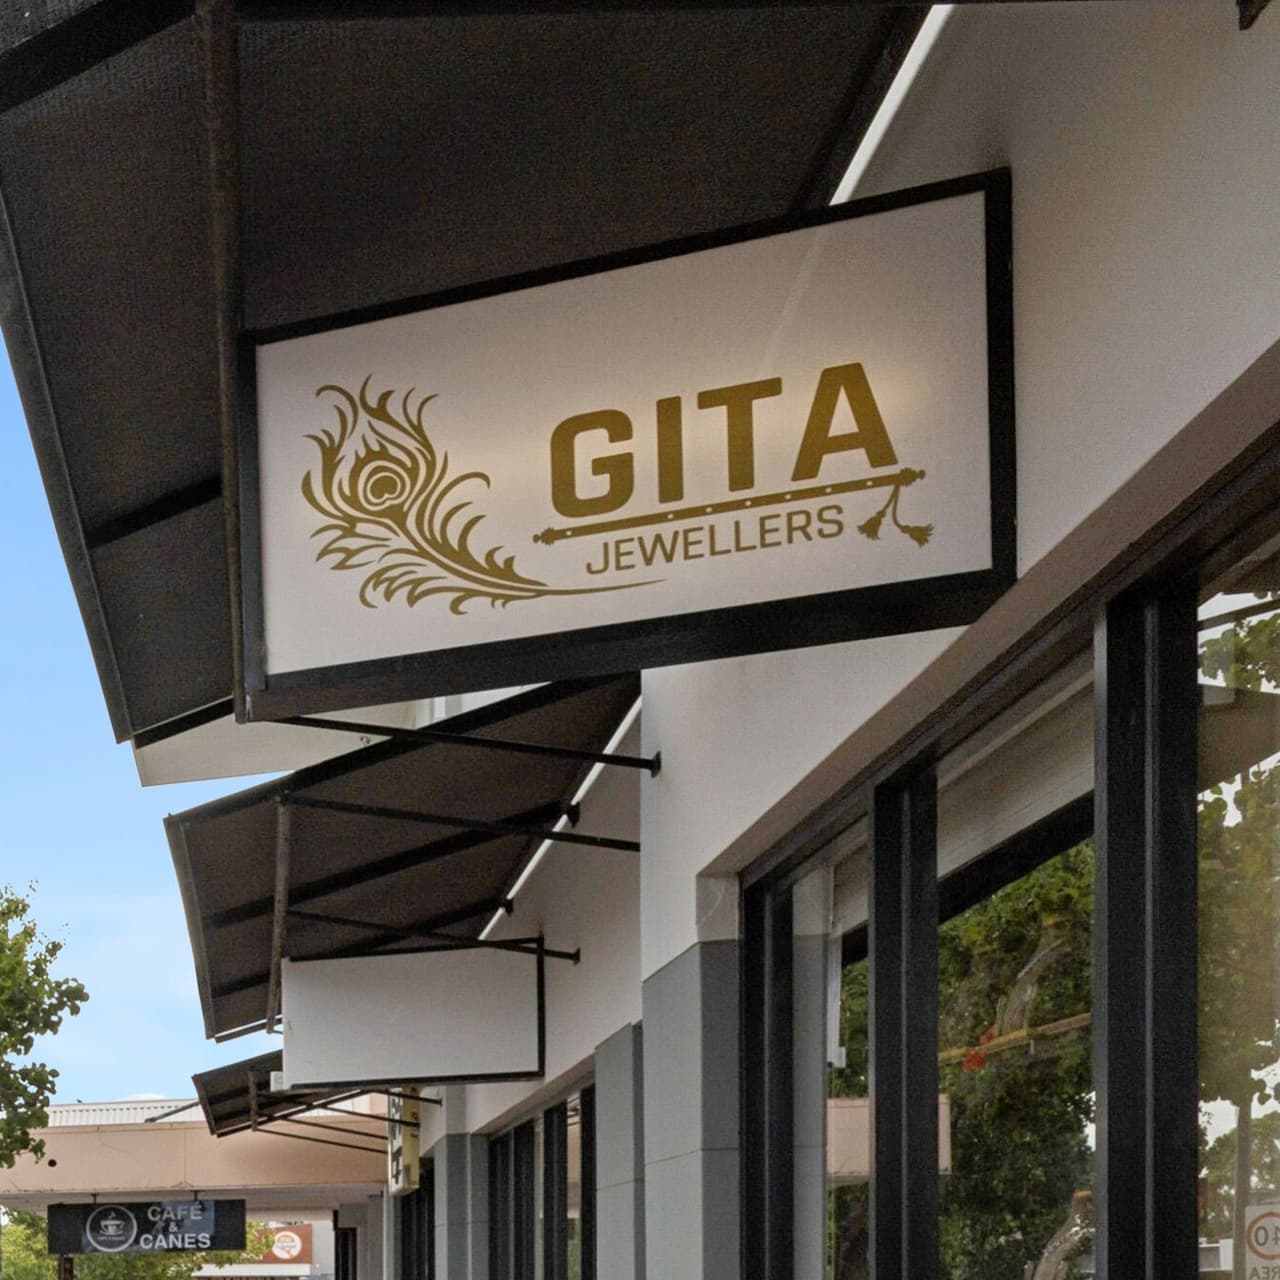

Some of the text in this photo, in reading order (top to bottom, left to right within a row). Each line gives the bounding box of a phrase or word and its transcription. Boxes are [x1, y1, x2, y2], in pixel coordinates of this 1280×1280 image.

[549, 362, 898, 520] GITA
[585, 504, 844, 577] JEWELLERS
[147, 1201, 203, 1220] CAFÉ
[168, 1221, 178, 1233] &
[140, 1233, 211, 1249] CANES
